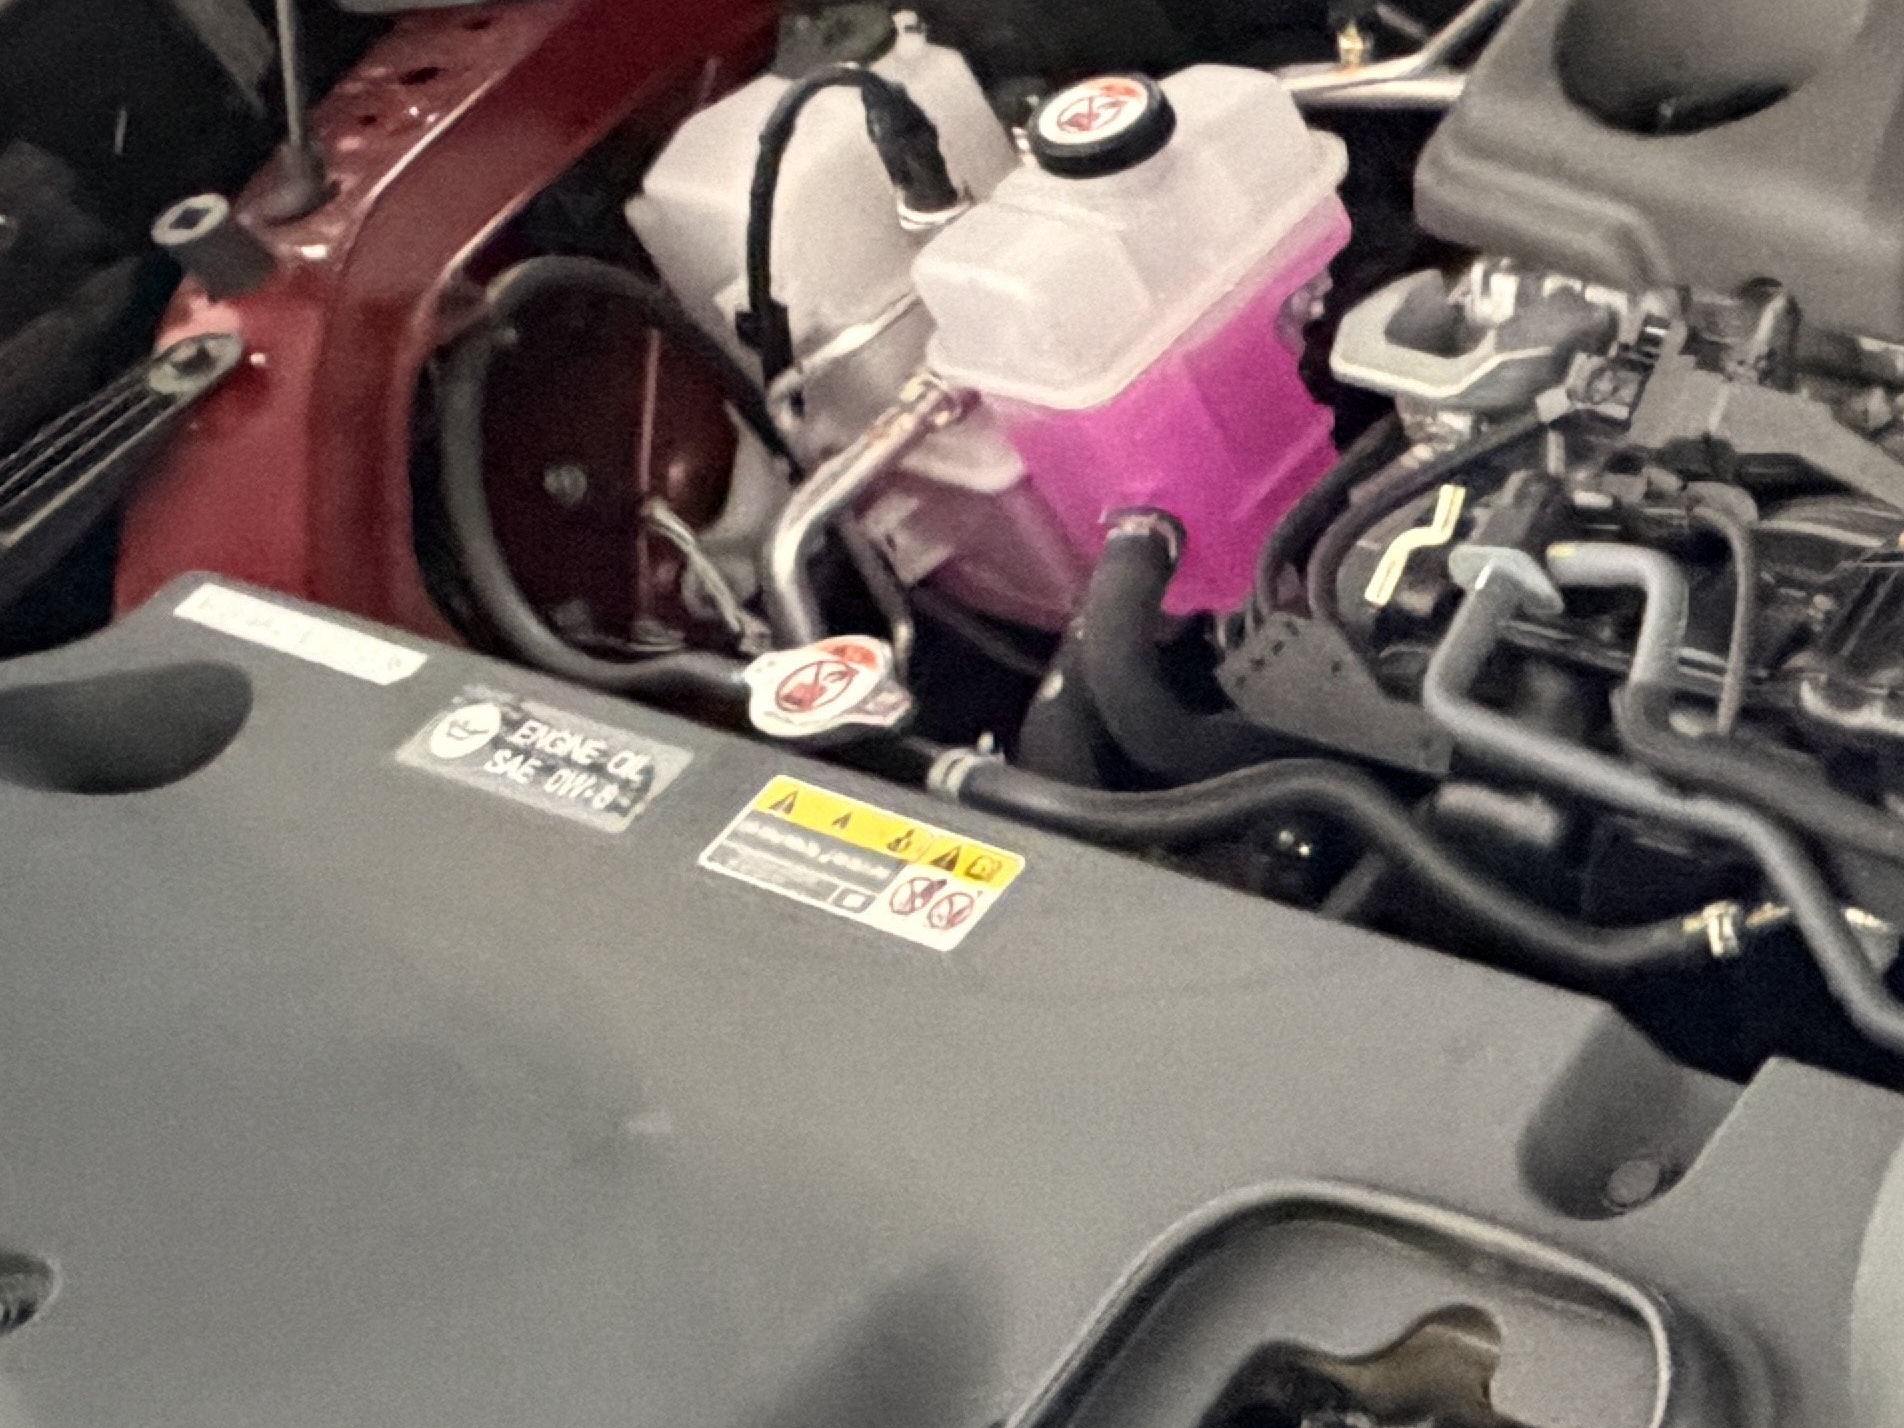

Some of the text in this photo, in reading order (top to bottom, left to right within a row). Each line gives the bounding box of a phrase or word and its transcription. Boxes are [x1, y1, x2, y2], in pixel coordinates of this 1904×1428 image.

[484, 749, 542, 784] SAE
[507, 720, 651, 781] ENGINE OIL
